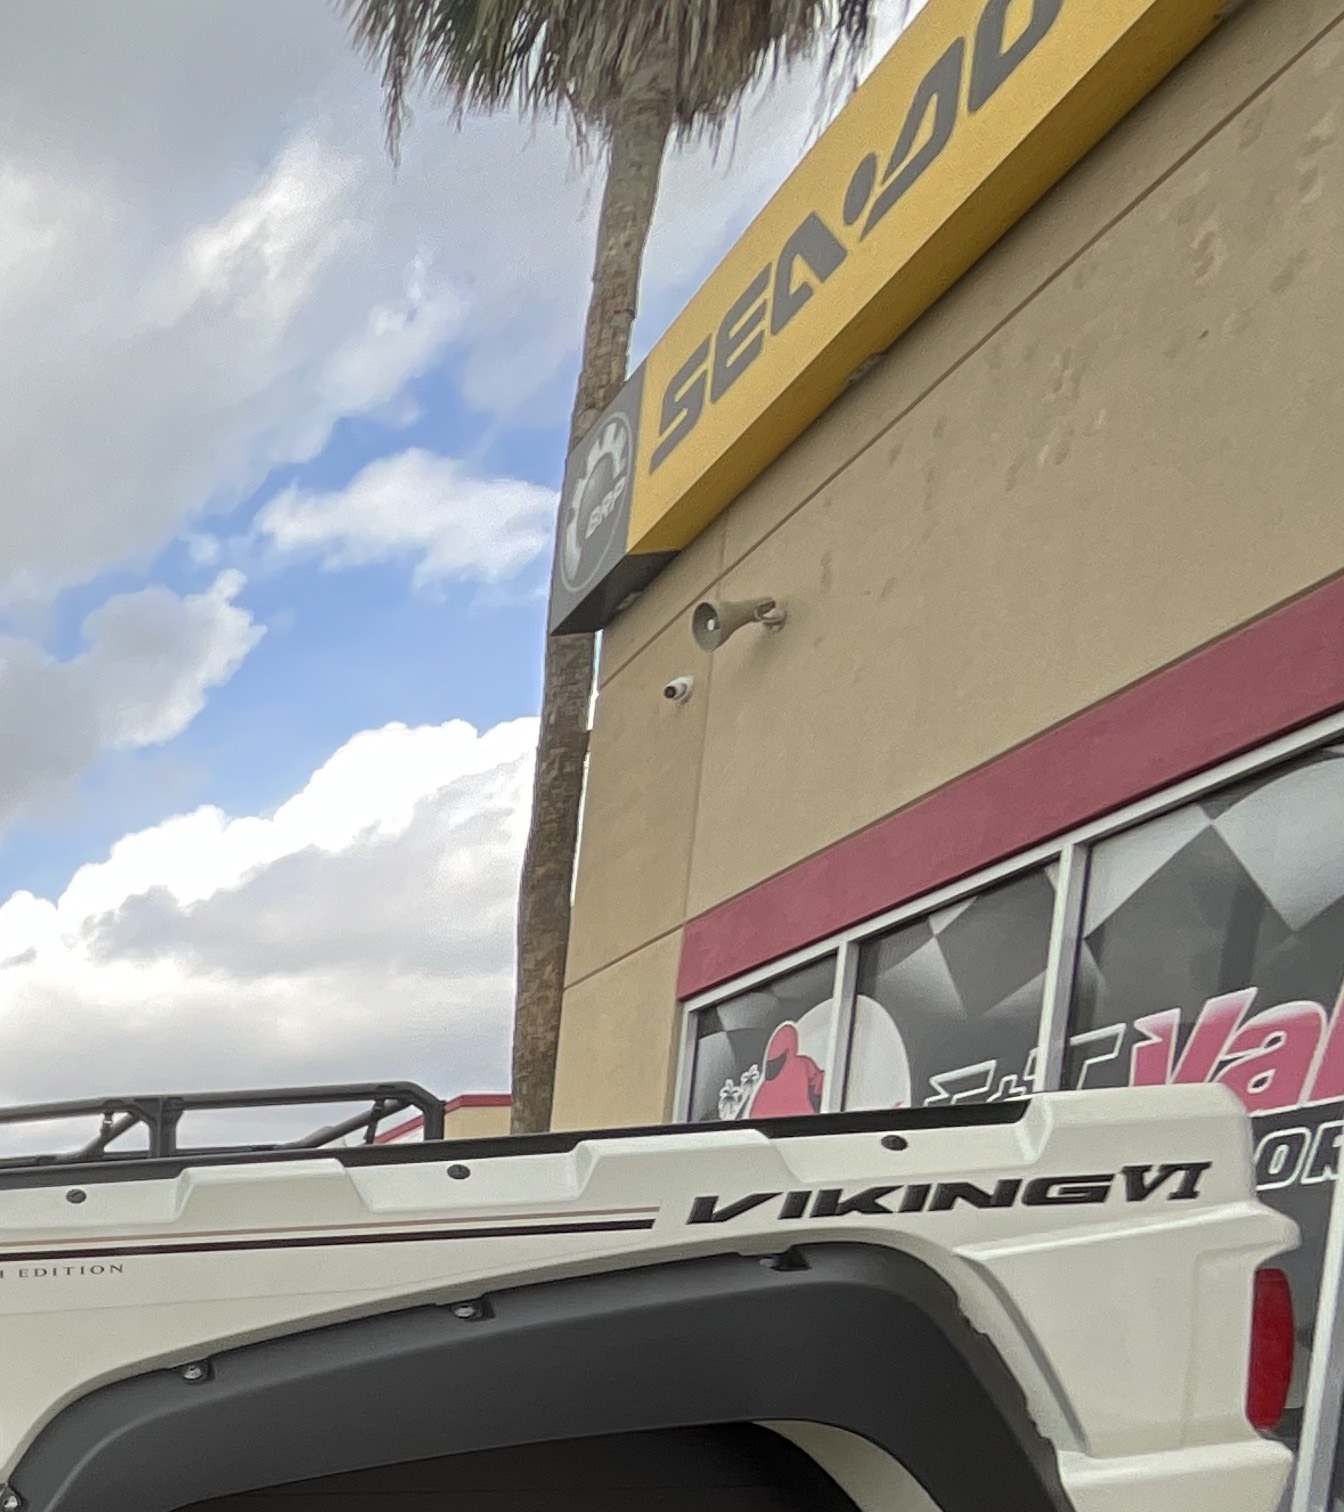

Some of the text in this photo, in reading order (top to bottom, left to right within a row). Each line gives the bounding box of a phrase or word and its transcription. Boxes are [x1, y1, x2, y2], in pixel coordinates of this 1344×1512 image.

[685, 1160, 1213, 1226] VIKING VI
[18, 1264, 124, 1278] EDITION
